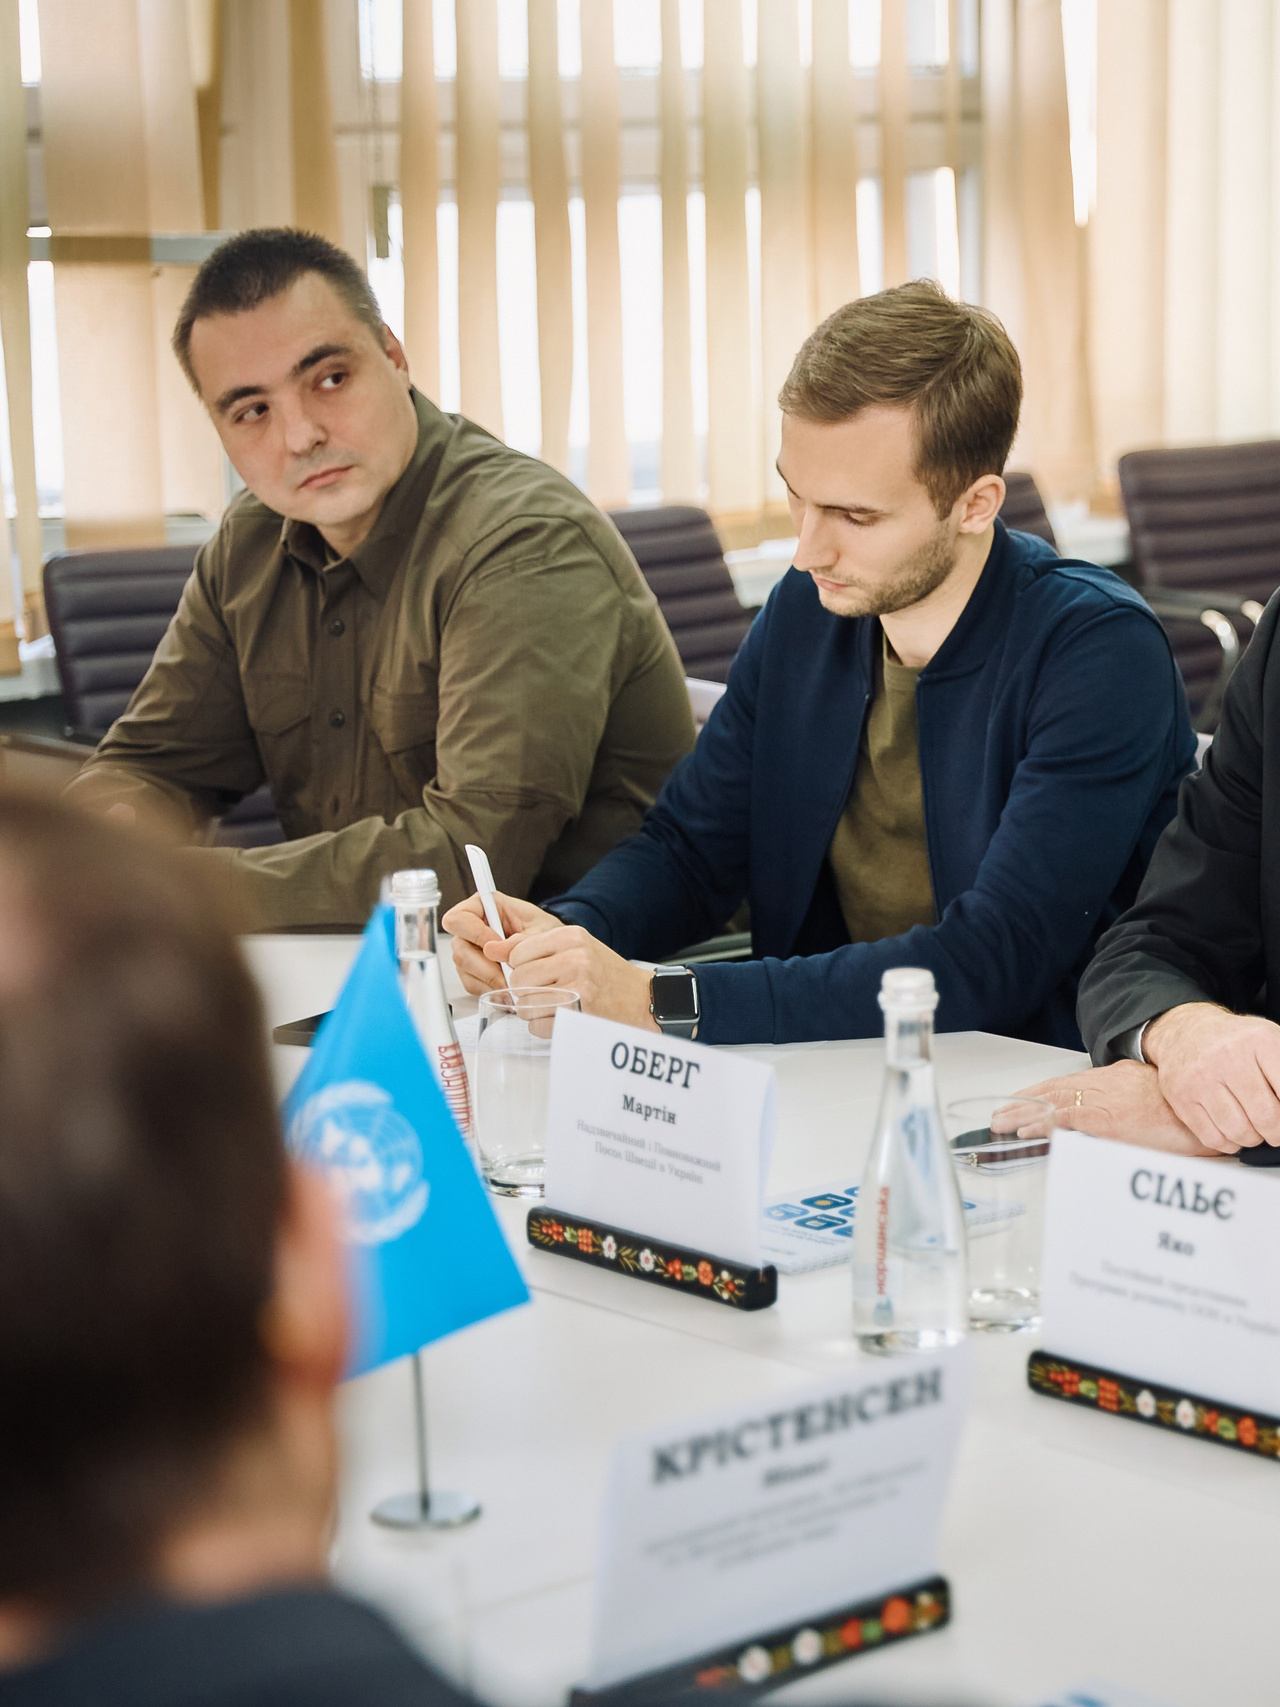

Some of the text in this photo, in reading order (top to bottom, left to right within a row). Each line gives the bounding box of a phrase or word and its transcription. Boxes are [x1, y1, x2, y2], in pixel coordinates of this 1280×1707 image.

[610, 1041, 700, 1089] ОБЕРГ
[622, 1094, 677, 1125] Мартін
[1130, 1169, 1236, 1221] СІЛЬЄ
[651, 1367, 943, 1486] КРІСТЕНСЕН
